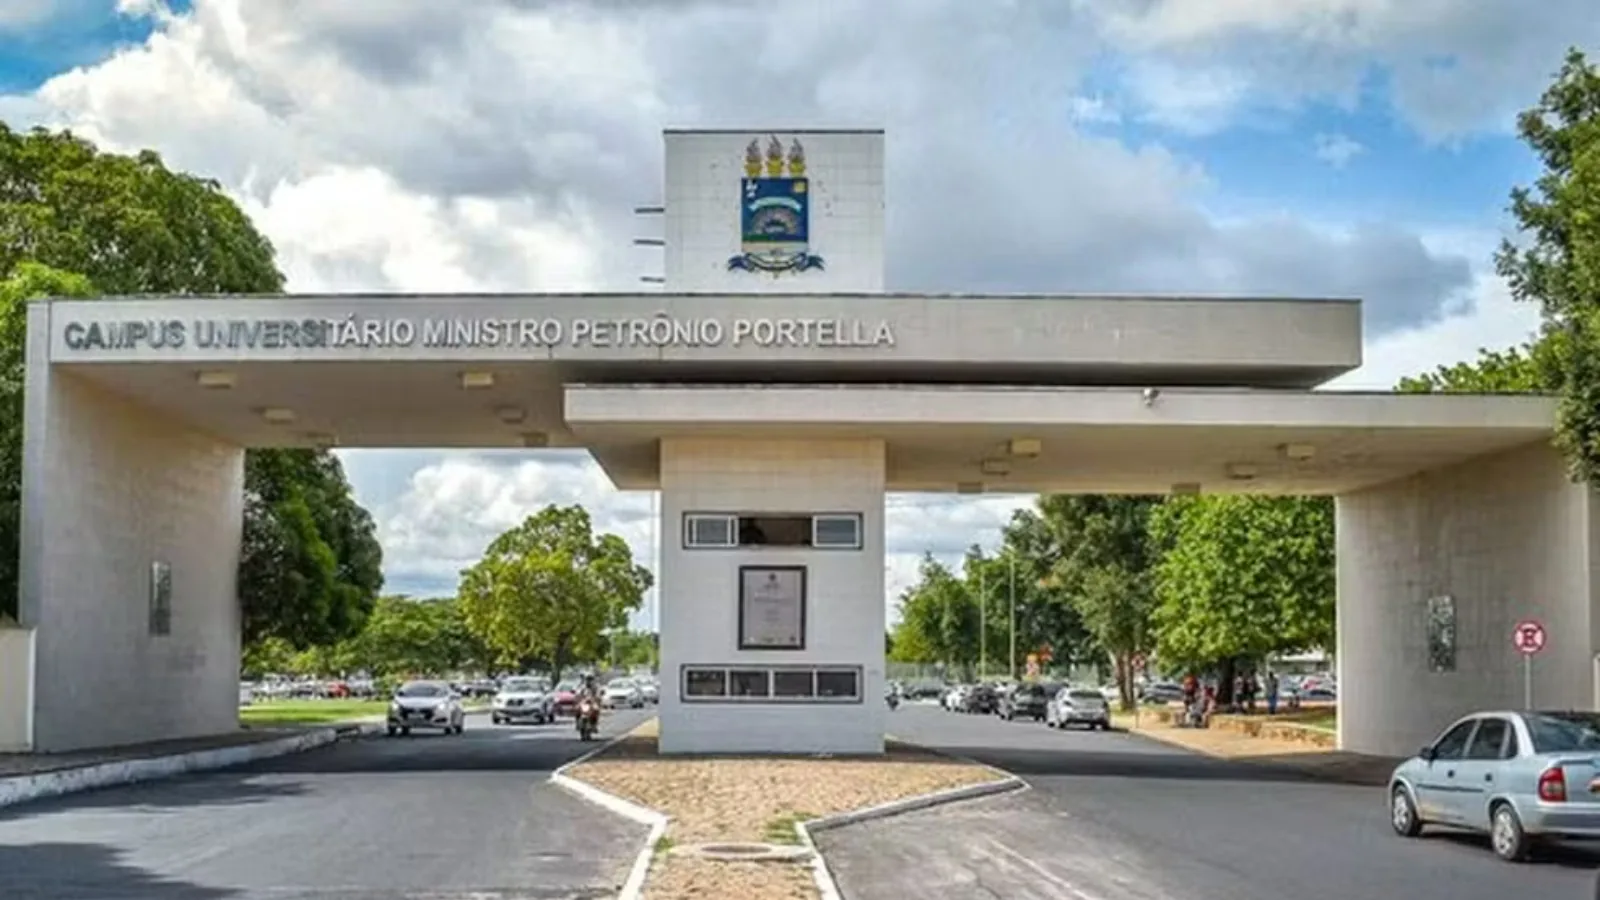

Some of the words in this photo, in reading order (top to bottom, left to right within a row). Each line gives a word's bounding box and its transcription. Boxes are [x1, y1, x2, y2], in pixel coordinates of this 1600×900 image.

[64, 321, 186, 350] CAMPUS
[193, 313, 415, 348] UNIVERSITÁRIO
[422, 318, 563, 347] MINISTRO
[570, 311, 723, 347] PETRÔNIO
[733, 318, 896, 347] PORTELLA
